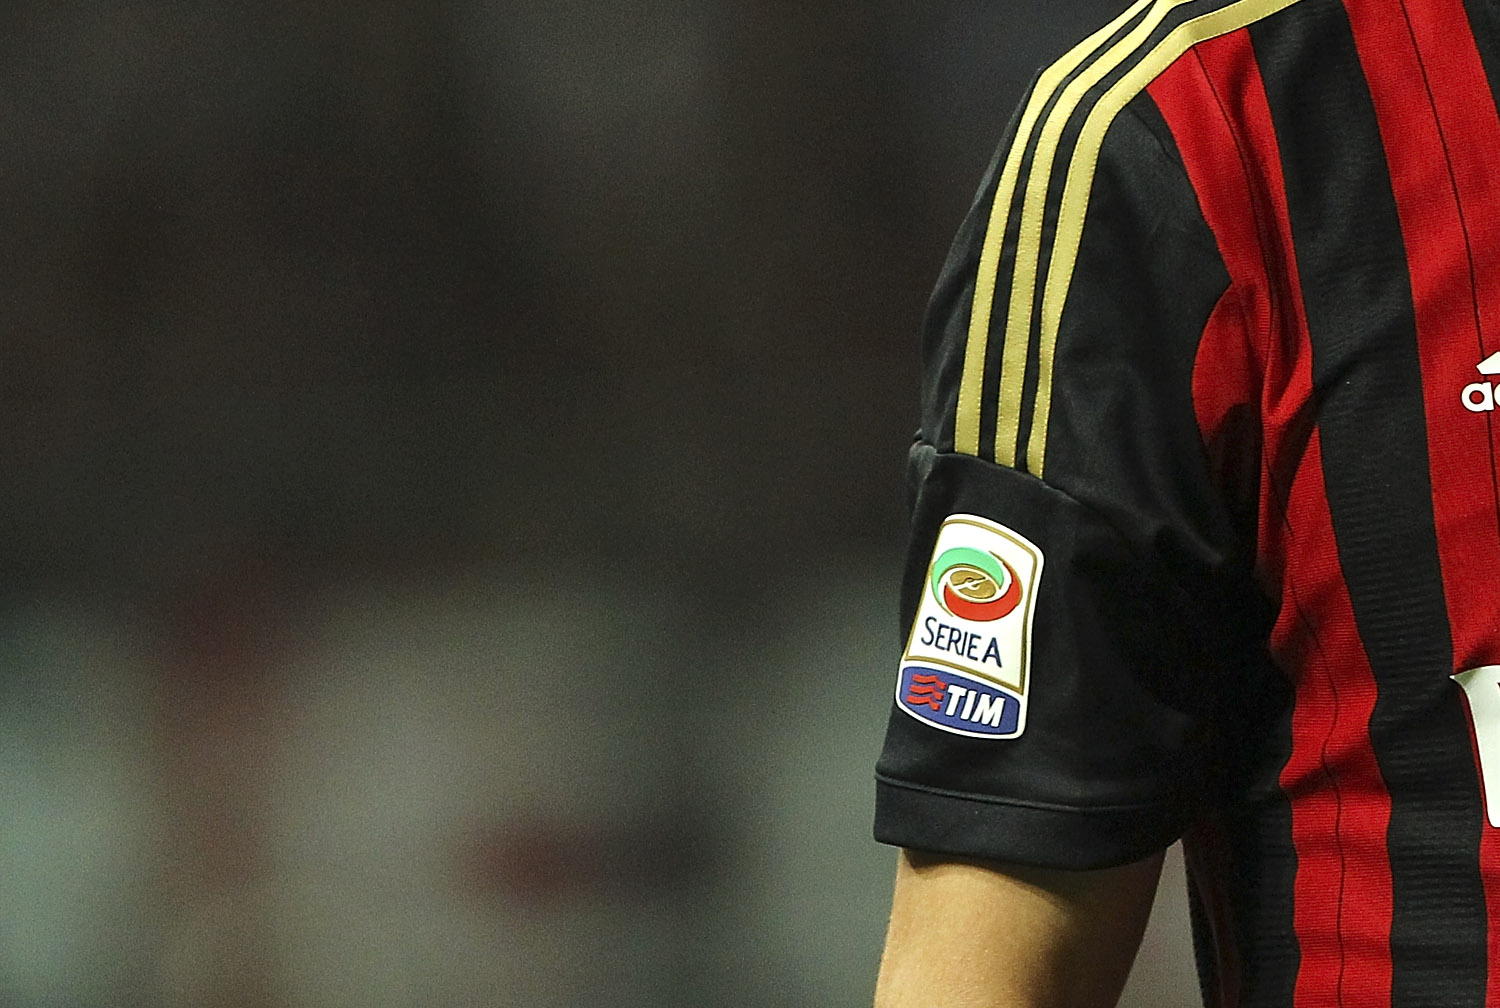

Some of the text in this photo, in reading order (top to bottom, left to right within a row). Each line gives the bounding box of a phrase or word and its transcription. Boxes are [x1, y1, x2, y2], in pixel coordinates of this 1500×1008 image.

[920, 616, 1003, 668] SERIE A
[945, 684, 1006, 728] TIM
